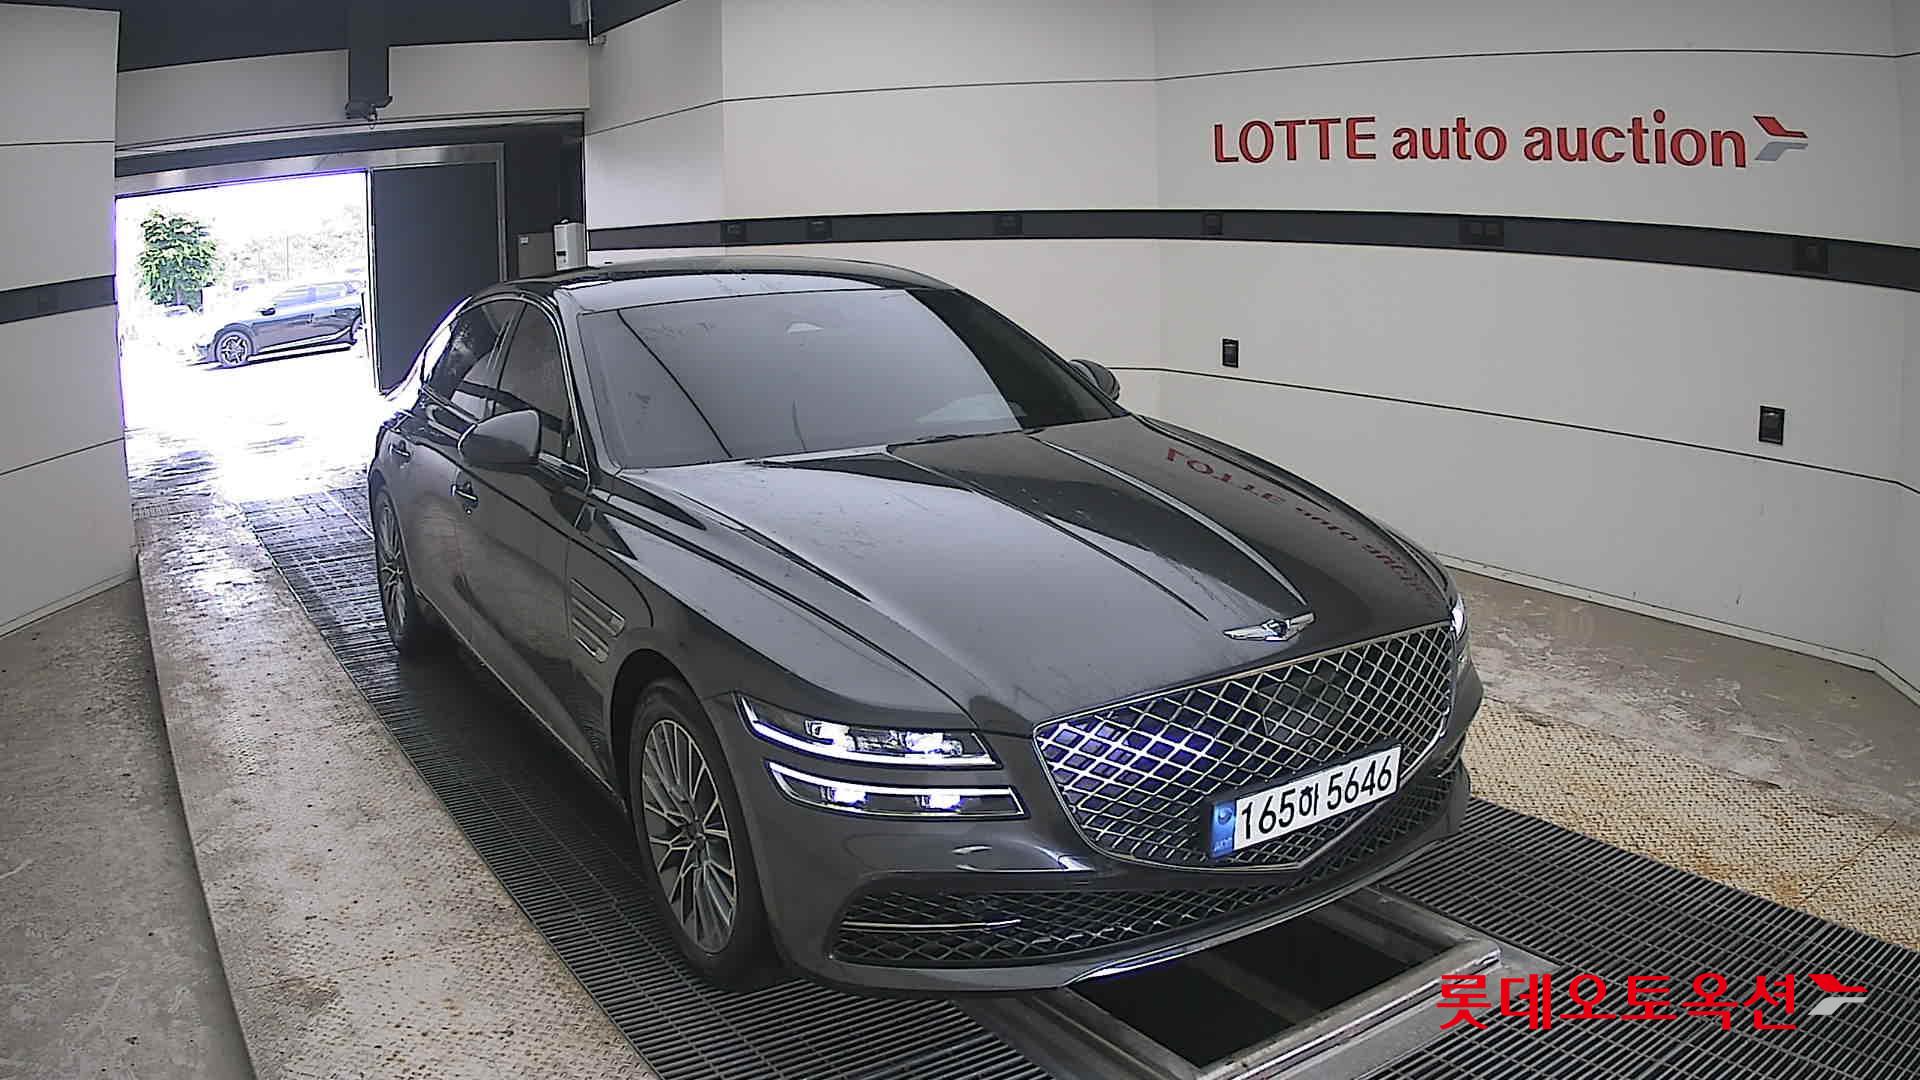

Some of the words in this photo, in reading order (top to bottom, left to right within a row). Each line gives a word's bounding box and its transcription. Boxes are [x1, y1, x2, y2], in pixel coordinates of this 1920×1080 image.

[1214, 116, 1376, 163] LOTTE
[1392, 116, 1507, 161] auto
[1523, 109, 1746, 168] auction
[1241, 782, 1320, 840] 165하
[1326, 755, 1392, 811] 5646
